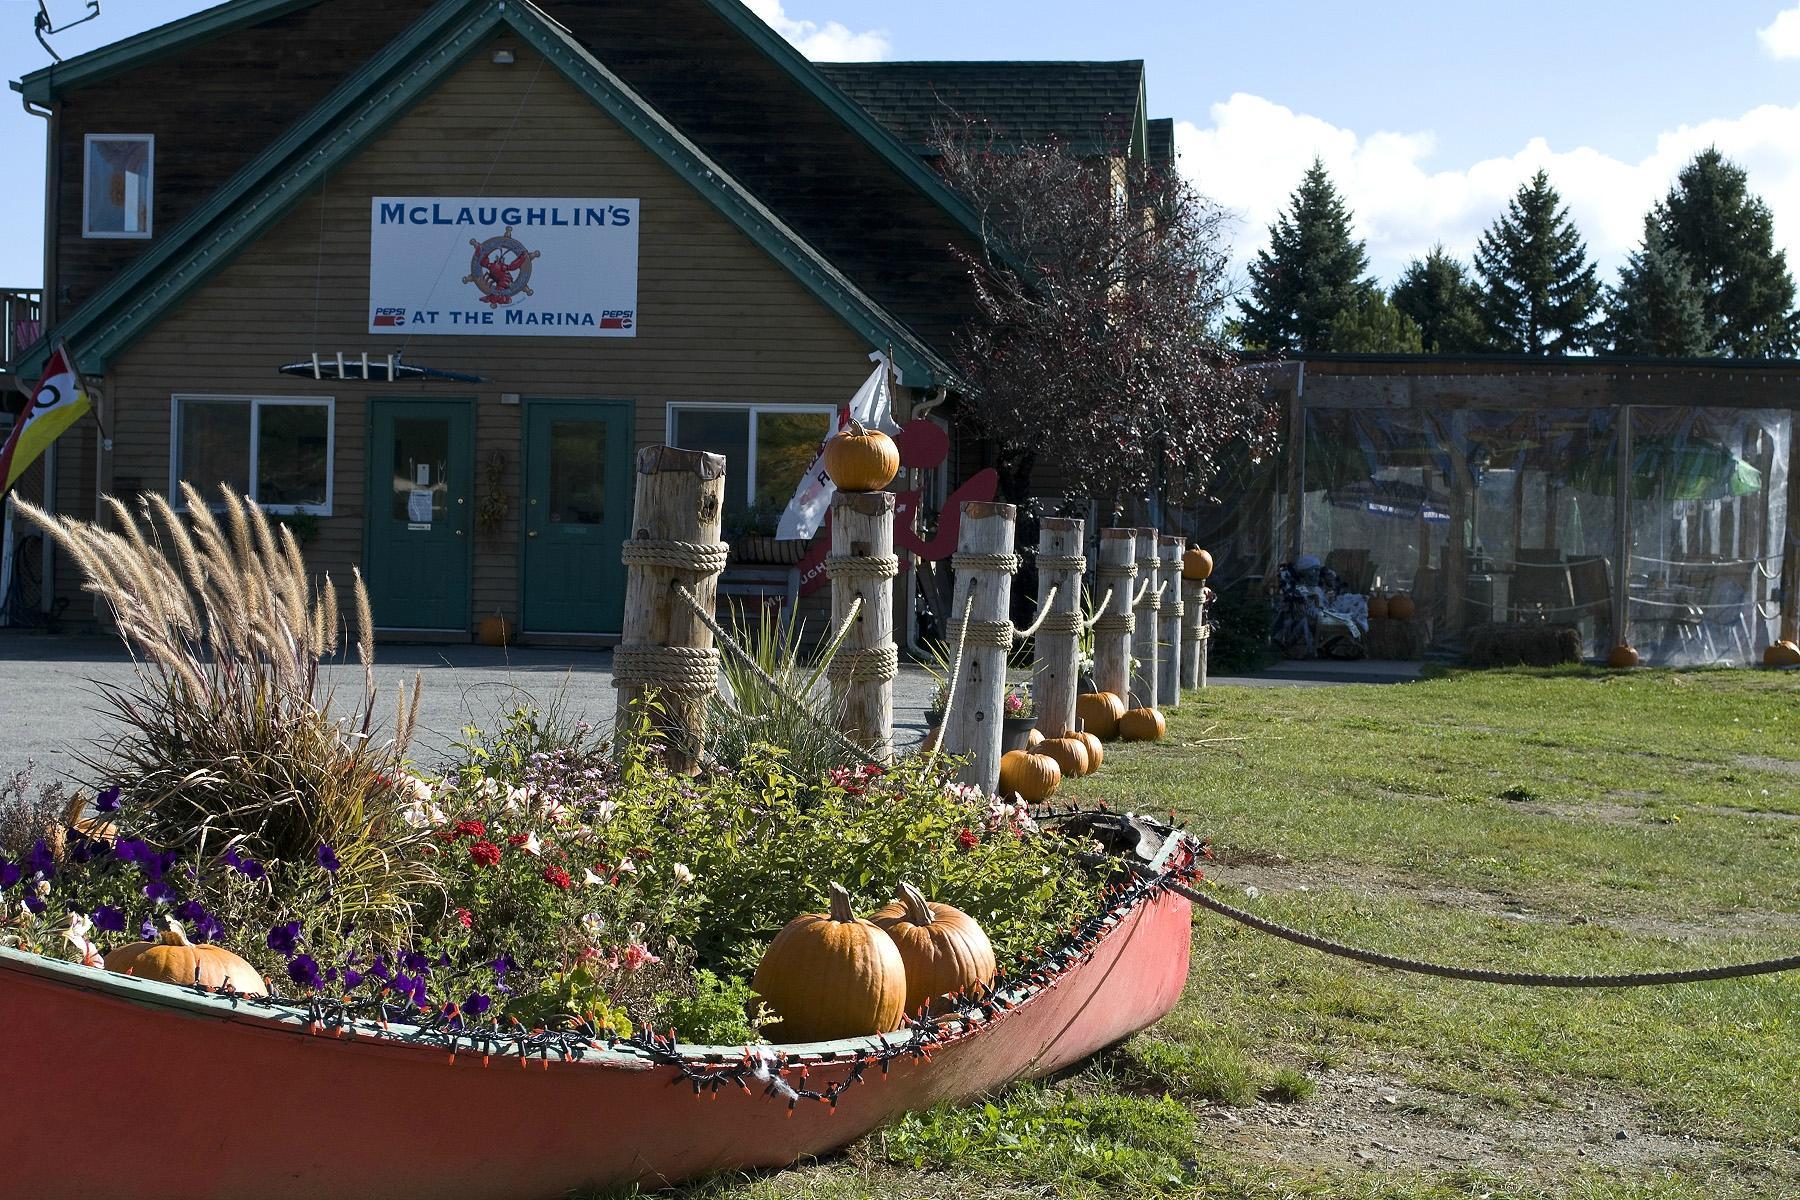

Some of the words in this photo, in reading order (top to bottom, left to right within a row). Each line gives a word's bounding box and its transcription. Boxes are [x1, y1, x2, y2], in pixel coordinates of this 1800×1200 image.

[375, 307, 406, 316] PEPSI
[602, 310, 633, 319] PEPSI
[412, 310, 440, 324] AT
[449, 310, 494, 325] THE
[505, 309, 595, 326] MARINA
